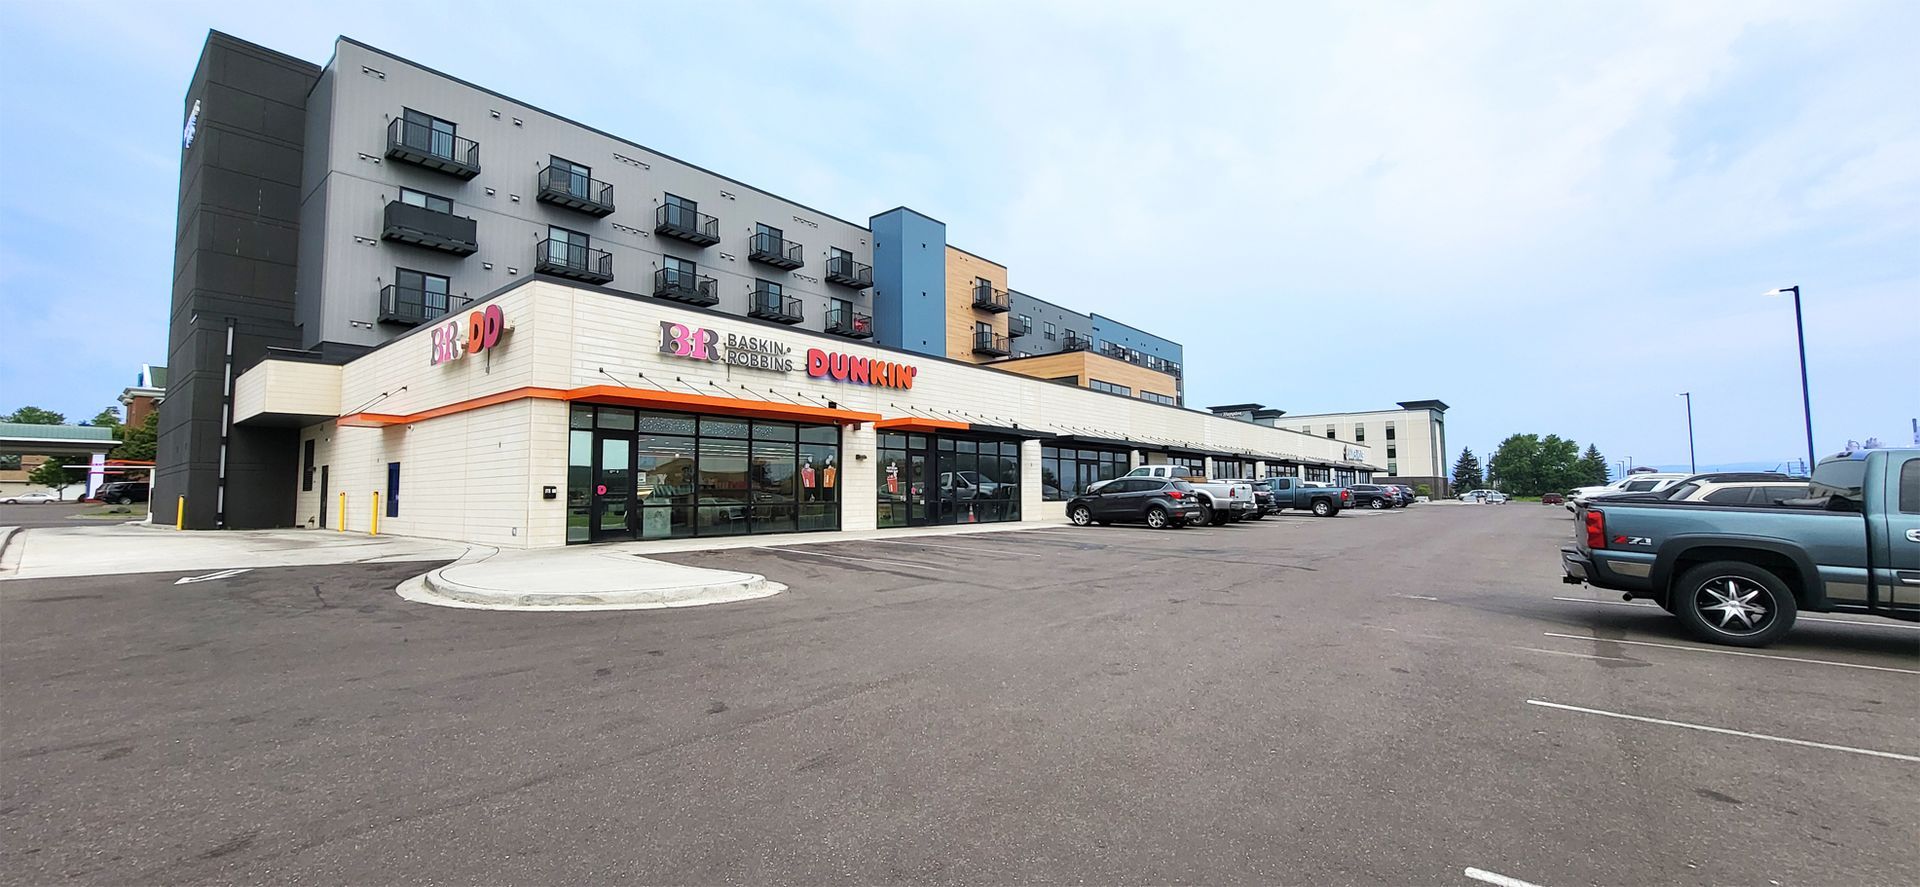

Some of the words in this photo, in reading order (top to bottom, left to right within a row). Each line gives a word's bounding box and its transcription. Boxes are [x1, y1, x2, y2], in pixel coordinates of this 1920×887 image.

[468, 304, 504, 354] DD
[659, 321, 721, 361] BR
[728, 351, 793, 372] ROBBINS
[807, 348, 917, 390] DUNKIN'
